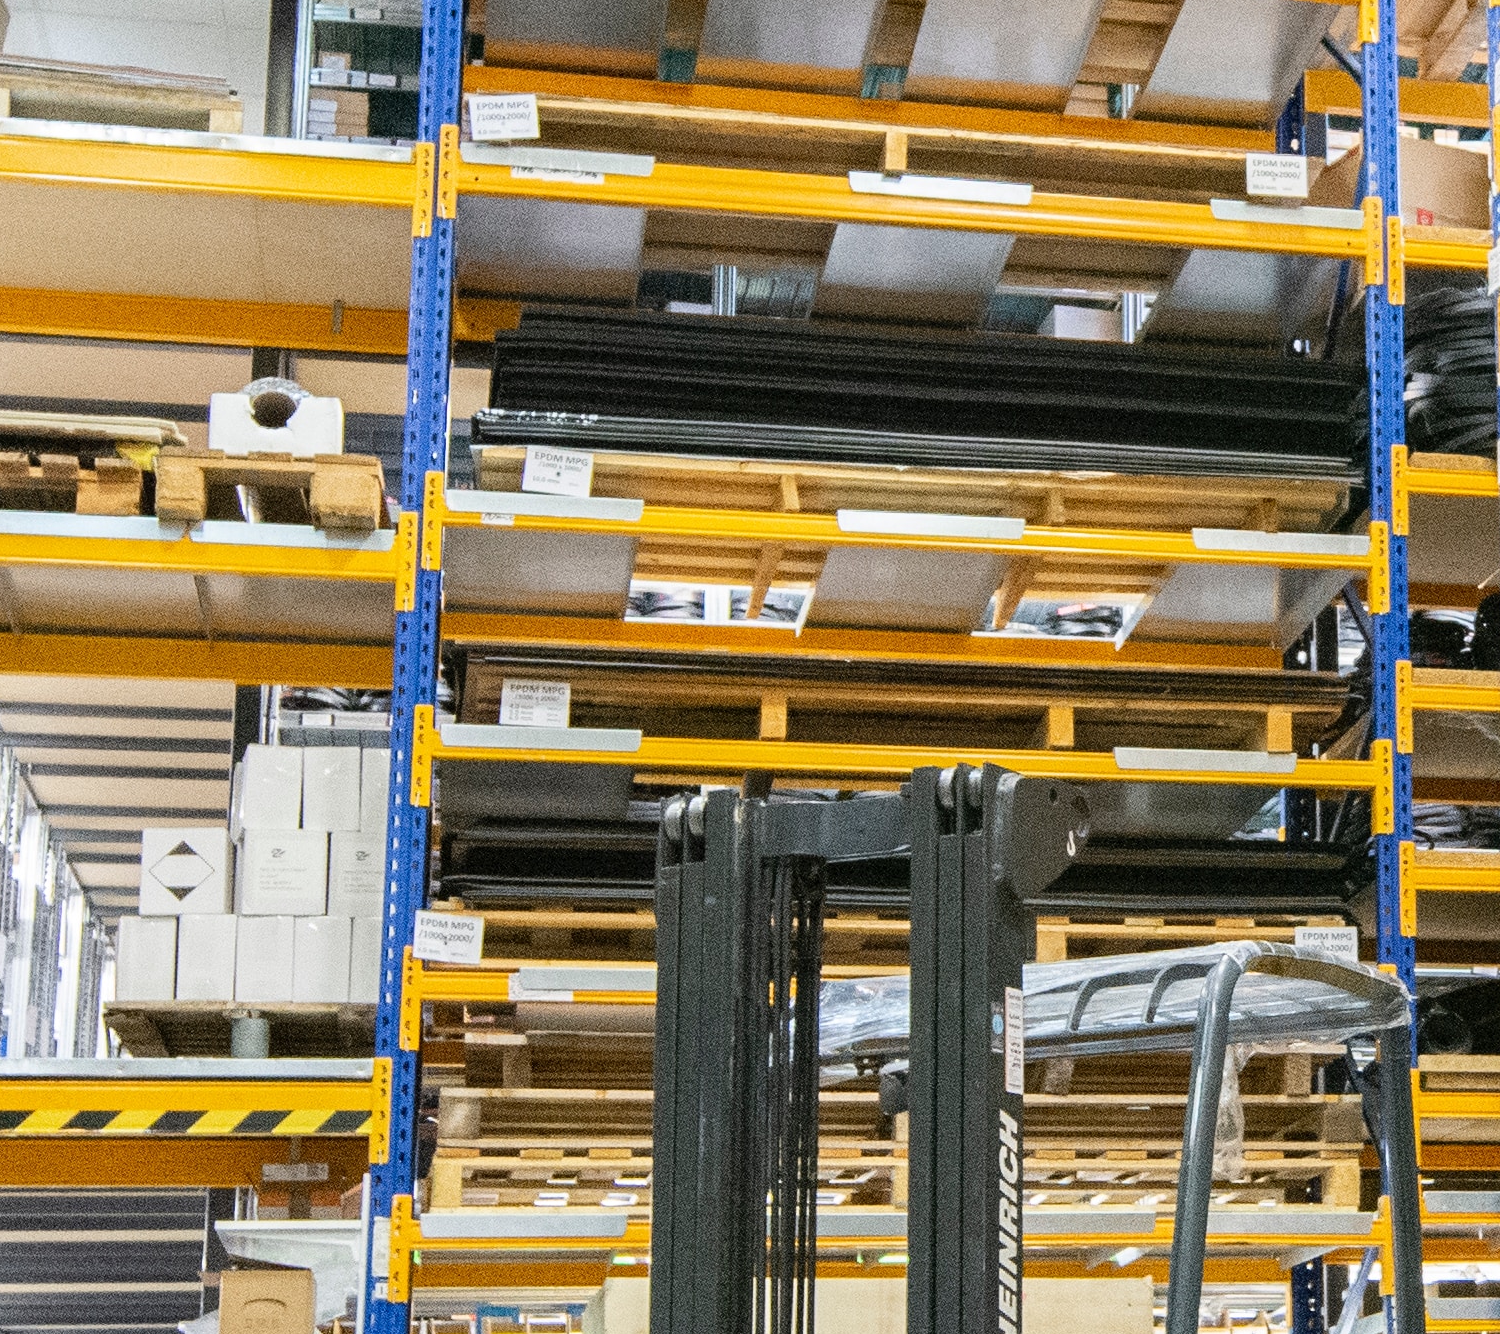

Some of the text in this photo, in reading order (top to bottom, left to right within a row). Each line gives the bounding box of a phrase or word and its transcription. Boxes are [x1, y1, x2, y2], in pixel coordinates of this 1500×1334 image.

[475, 101, 530, 111] EPDM MPG
[1252, 159, 1301, 168] EPDM MPG
[535, 452, 590, 467] EPDM MPG
[510, 683, 566, 695] EPDM MPG
[420, 916, 476, 932] EPDM MPG
[1302, 932, 1353, 941] EPDM MPG
